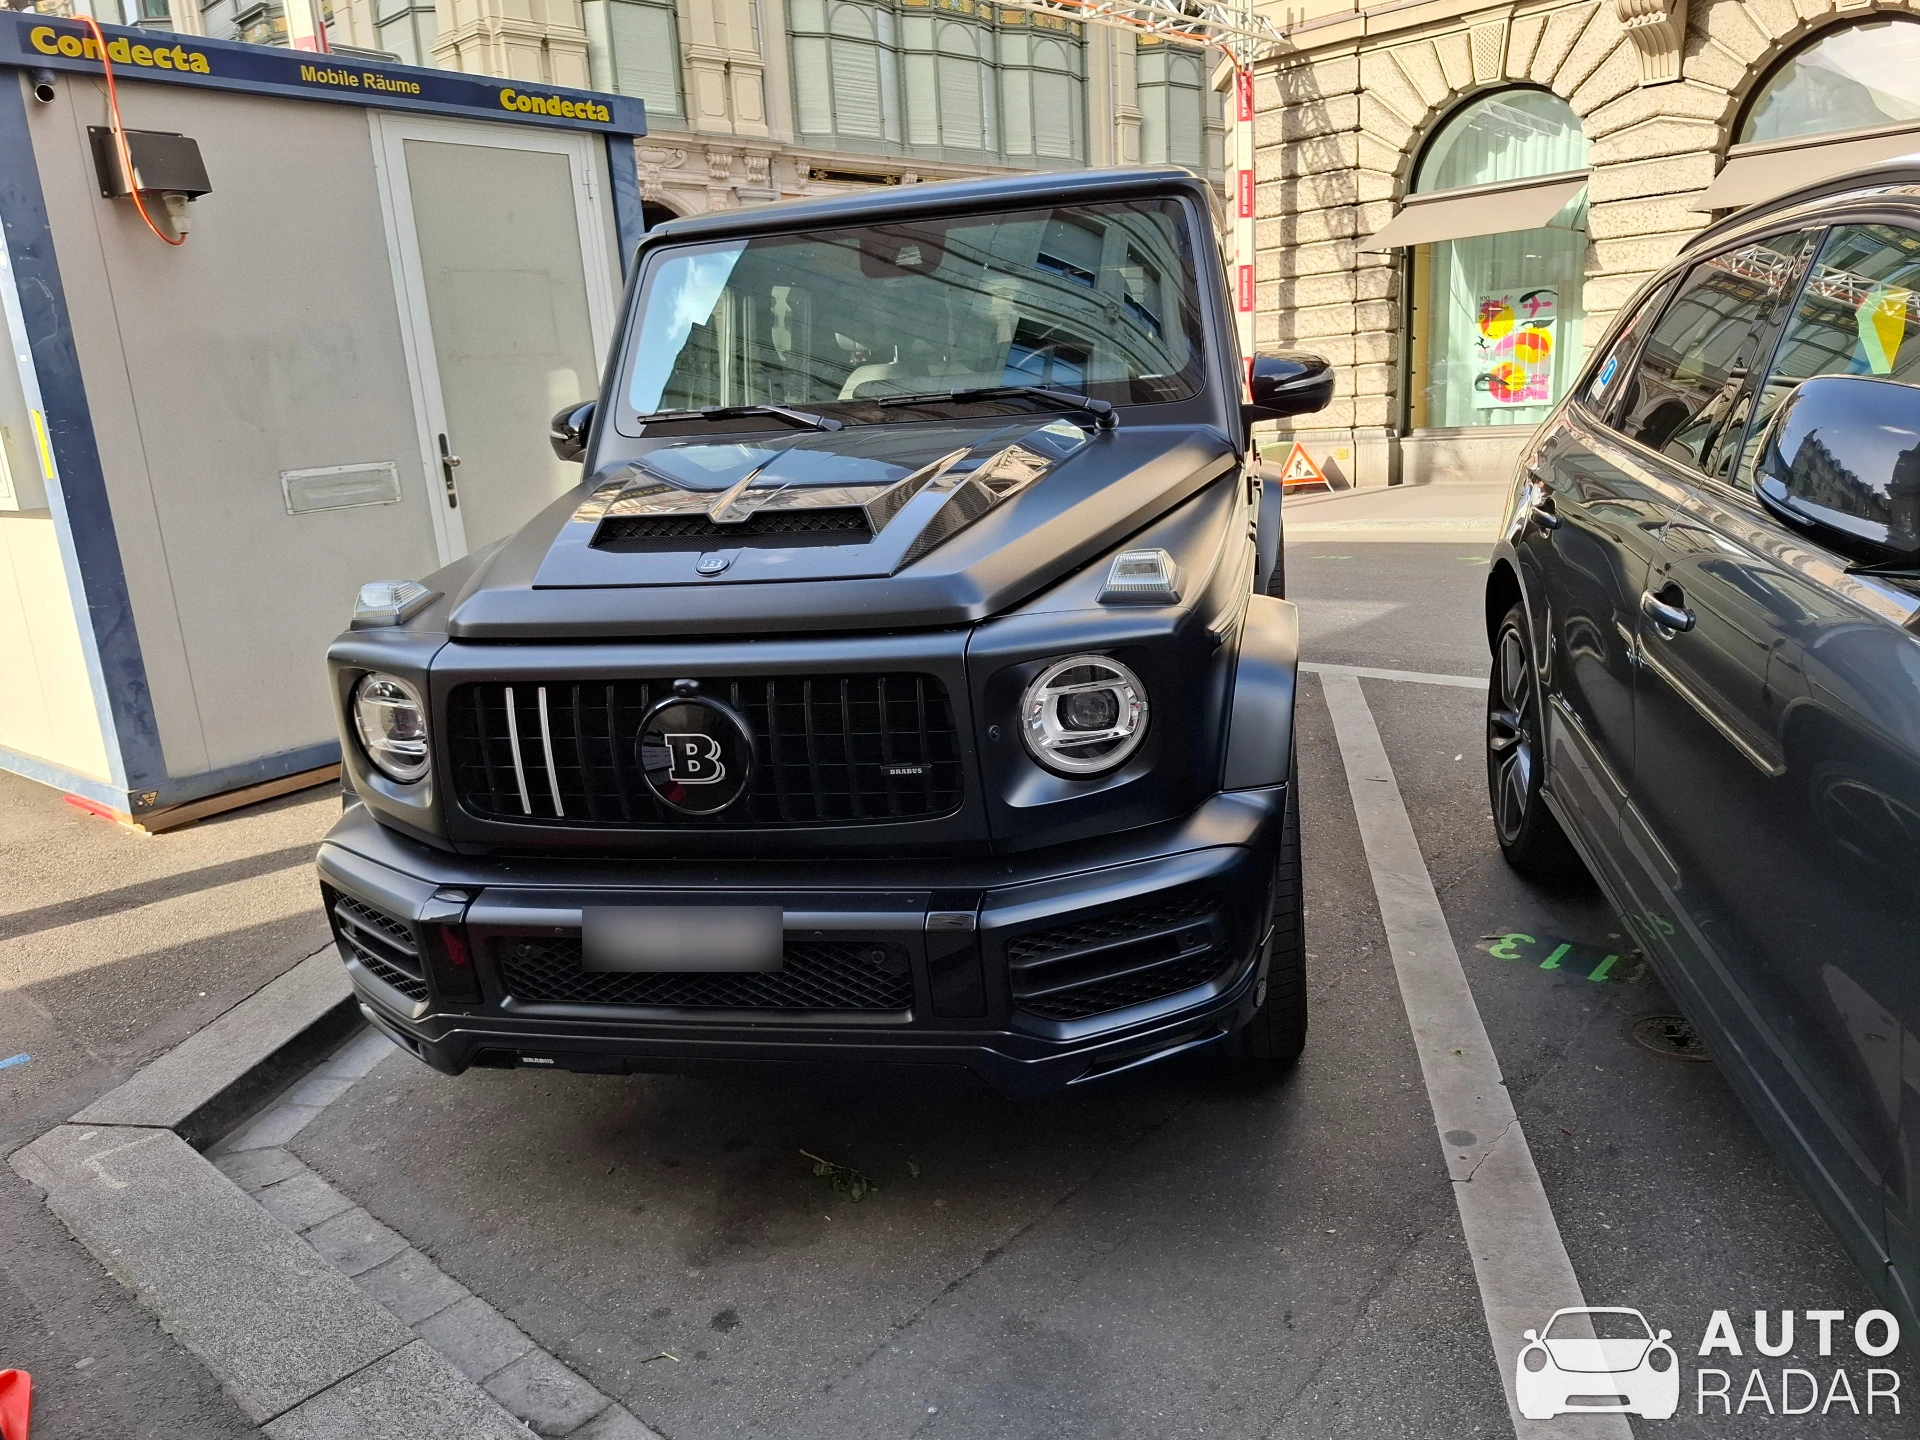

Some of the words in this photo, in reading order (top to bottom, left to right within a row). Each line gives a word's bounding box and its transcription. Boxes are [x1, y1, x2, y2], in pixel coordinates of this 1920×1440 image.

[30, 26, 210, 74] Condecta
[300, 65, 359, 87] Mobile
[363, 72, 420, 95] Räume
[500, 88, 610, 122] Condecta
[889, 767, 923, 775] BRABUS
